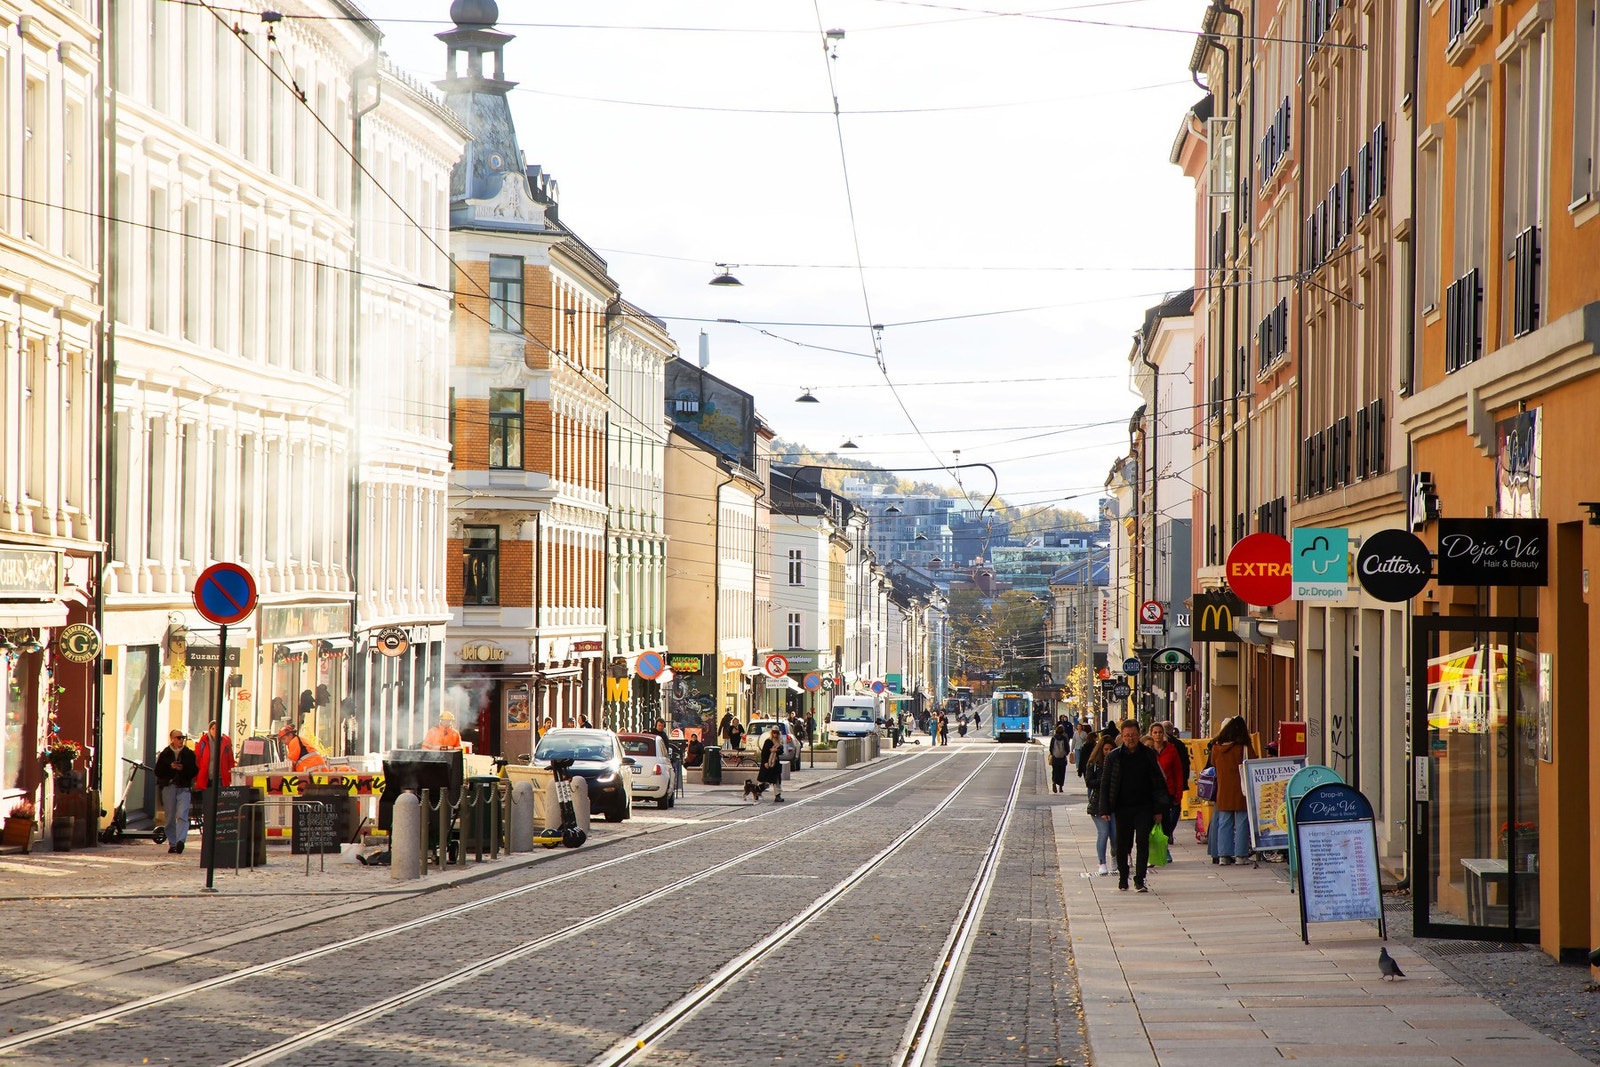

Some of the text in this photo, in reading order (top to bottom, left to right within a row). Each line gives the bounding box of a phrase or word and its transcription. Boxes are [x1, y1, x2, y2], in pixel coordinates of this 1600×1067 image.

[1232, 562, 1292, 576] EXTRA
[1483, 560, 1539, 570] Hair & Beauty
[1298, 586, 1342, 598] Dr.Dropin
[68, 634, 90, 654] G
[462, 644, 477, 660] Deli
[490, 644, 505, 660] Luca
